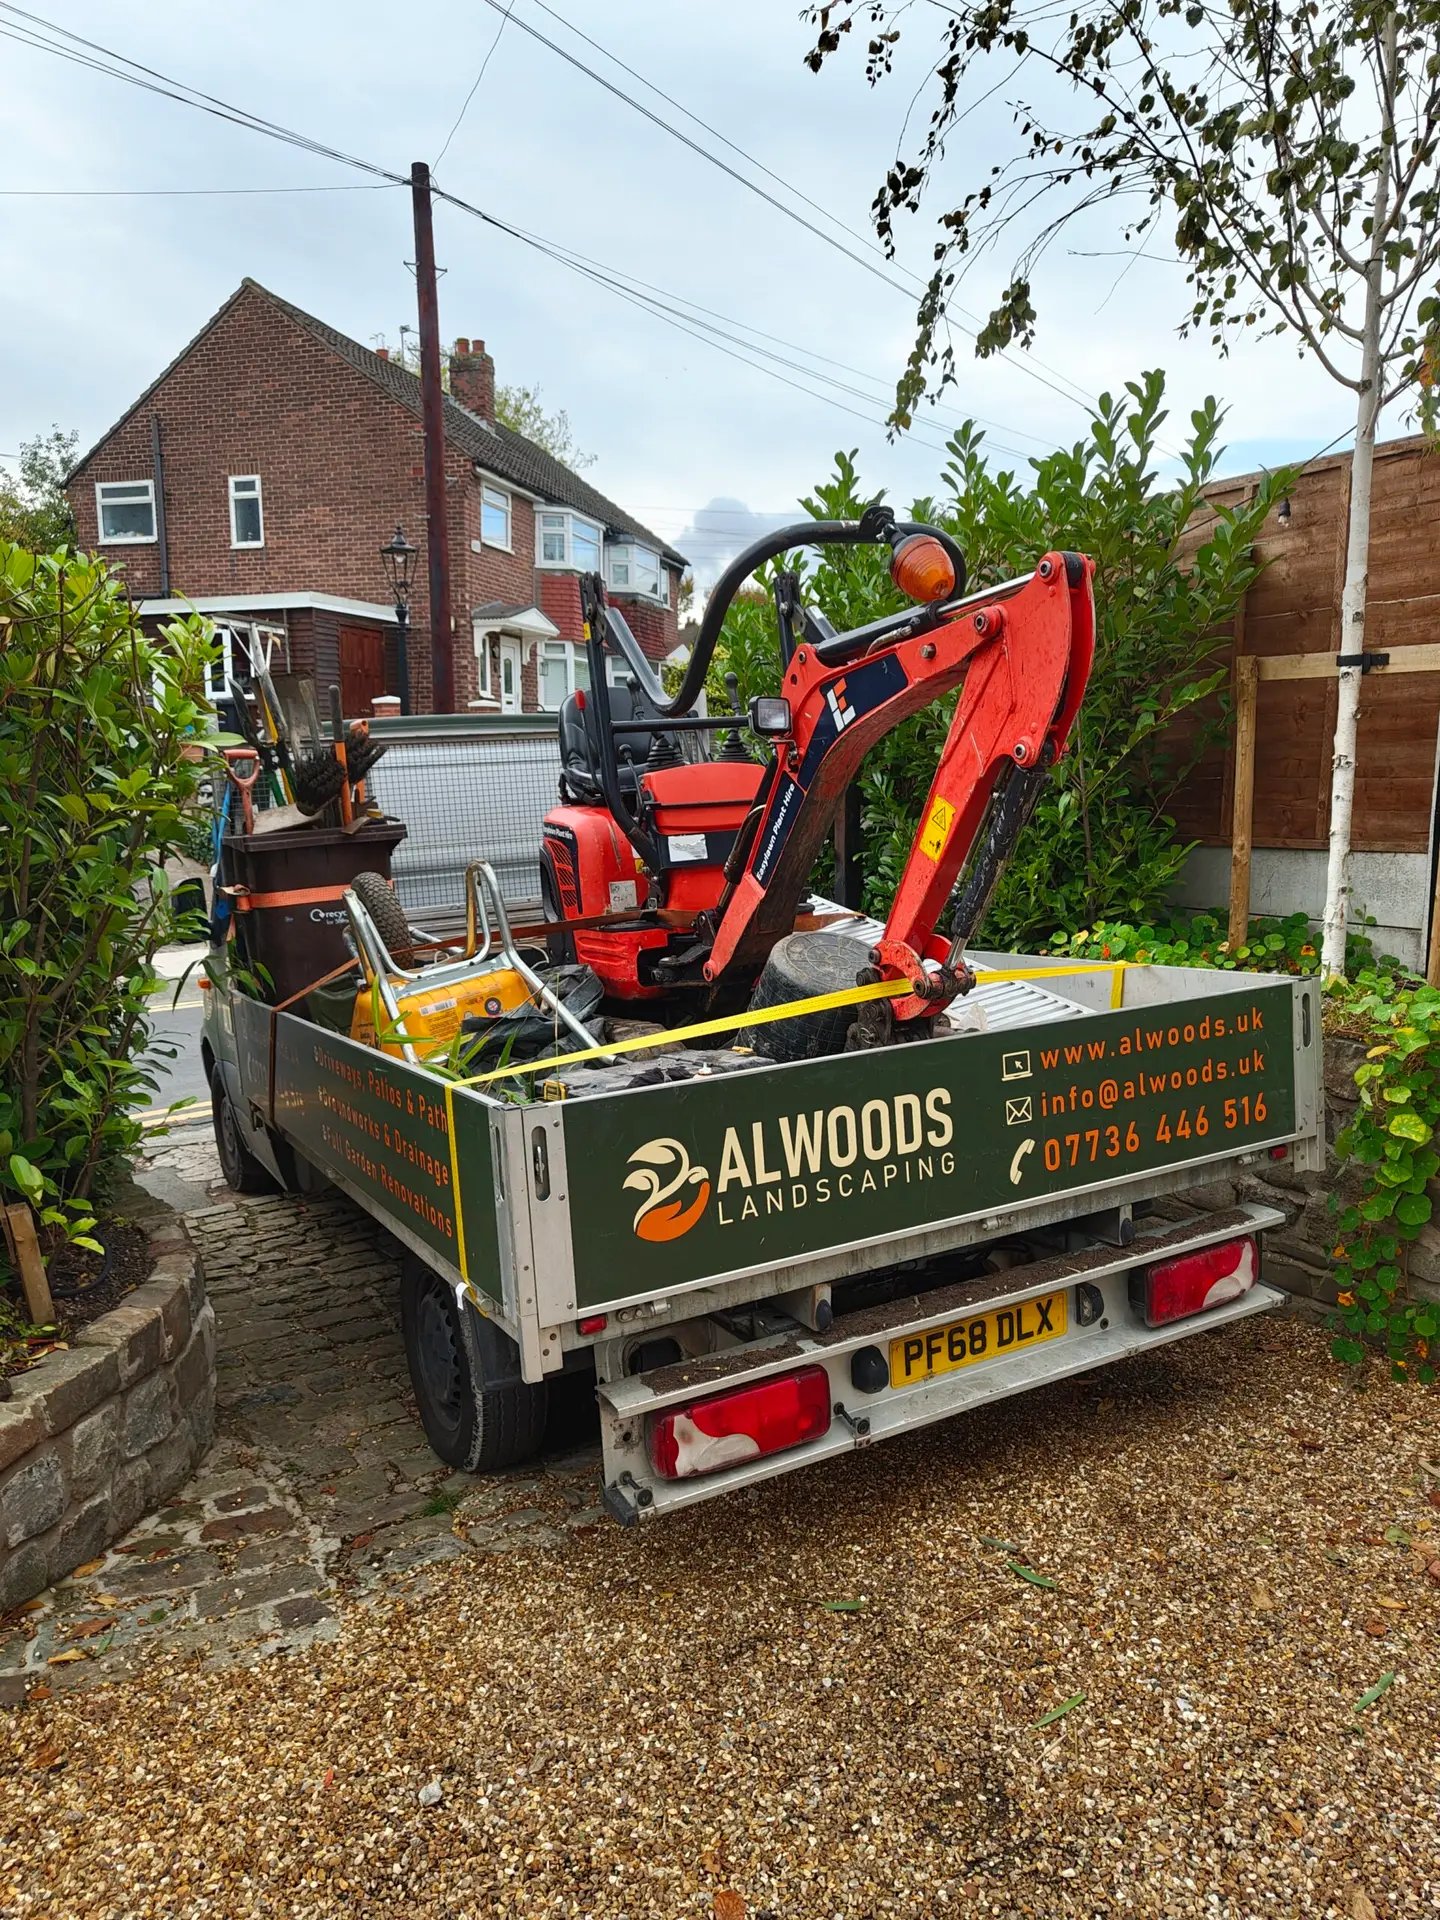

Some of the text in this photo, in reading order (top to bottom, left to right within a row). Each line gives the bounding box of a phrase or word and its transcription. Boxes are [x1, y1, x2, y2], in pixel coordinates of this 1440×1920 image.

[756, 783, 795, 881] Easylawn Plant Hire
[325, 910, 348, 919] recyc
[1039, 1007, 1265, 1070] www.alwoods.uk
[317, 1046, 366, 1092] Driveways,
[368, 1070, 402, 1109] Patios
[406, 1088, 415, 1116] &
[418, 1094, 449, 1135] Path
[1041, 1049, 1265, 1118] info@alwoods.uk
[322, 1085, 449, 1187] Groundworks & Drainage
[717, 1087, 954, 1194] ALWOODS
[1044, 1092, 1267, 1172] 07736 446 516
[326, 1124, 453, 1239] Full Garden Renovations
[718, 1151, 956, 1225] LANDSCAPING
[903, 1299, 1054, 1377] PF68 DLX
